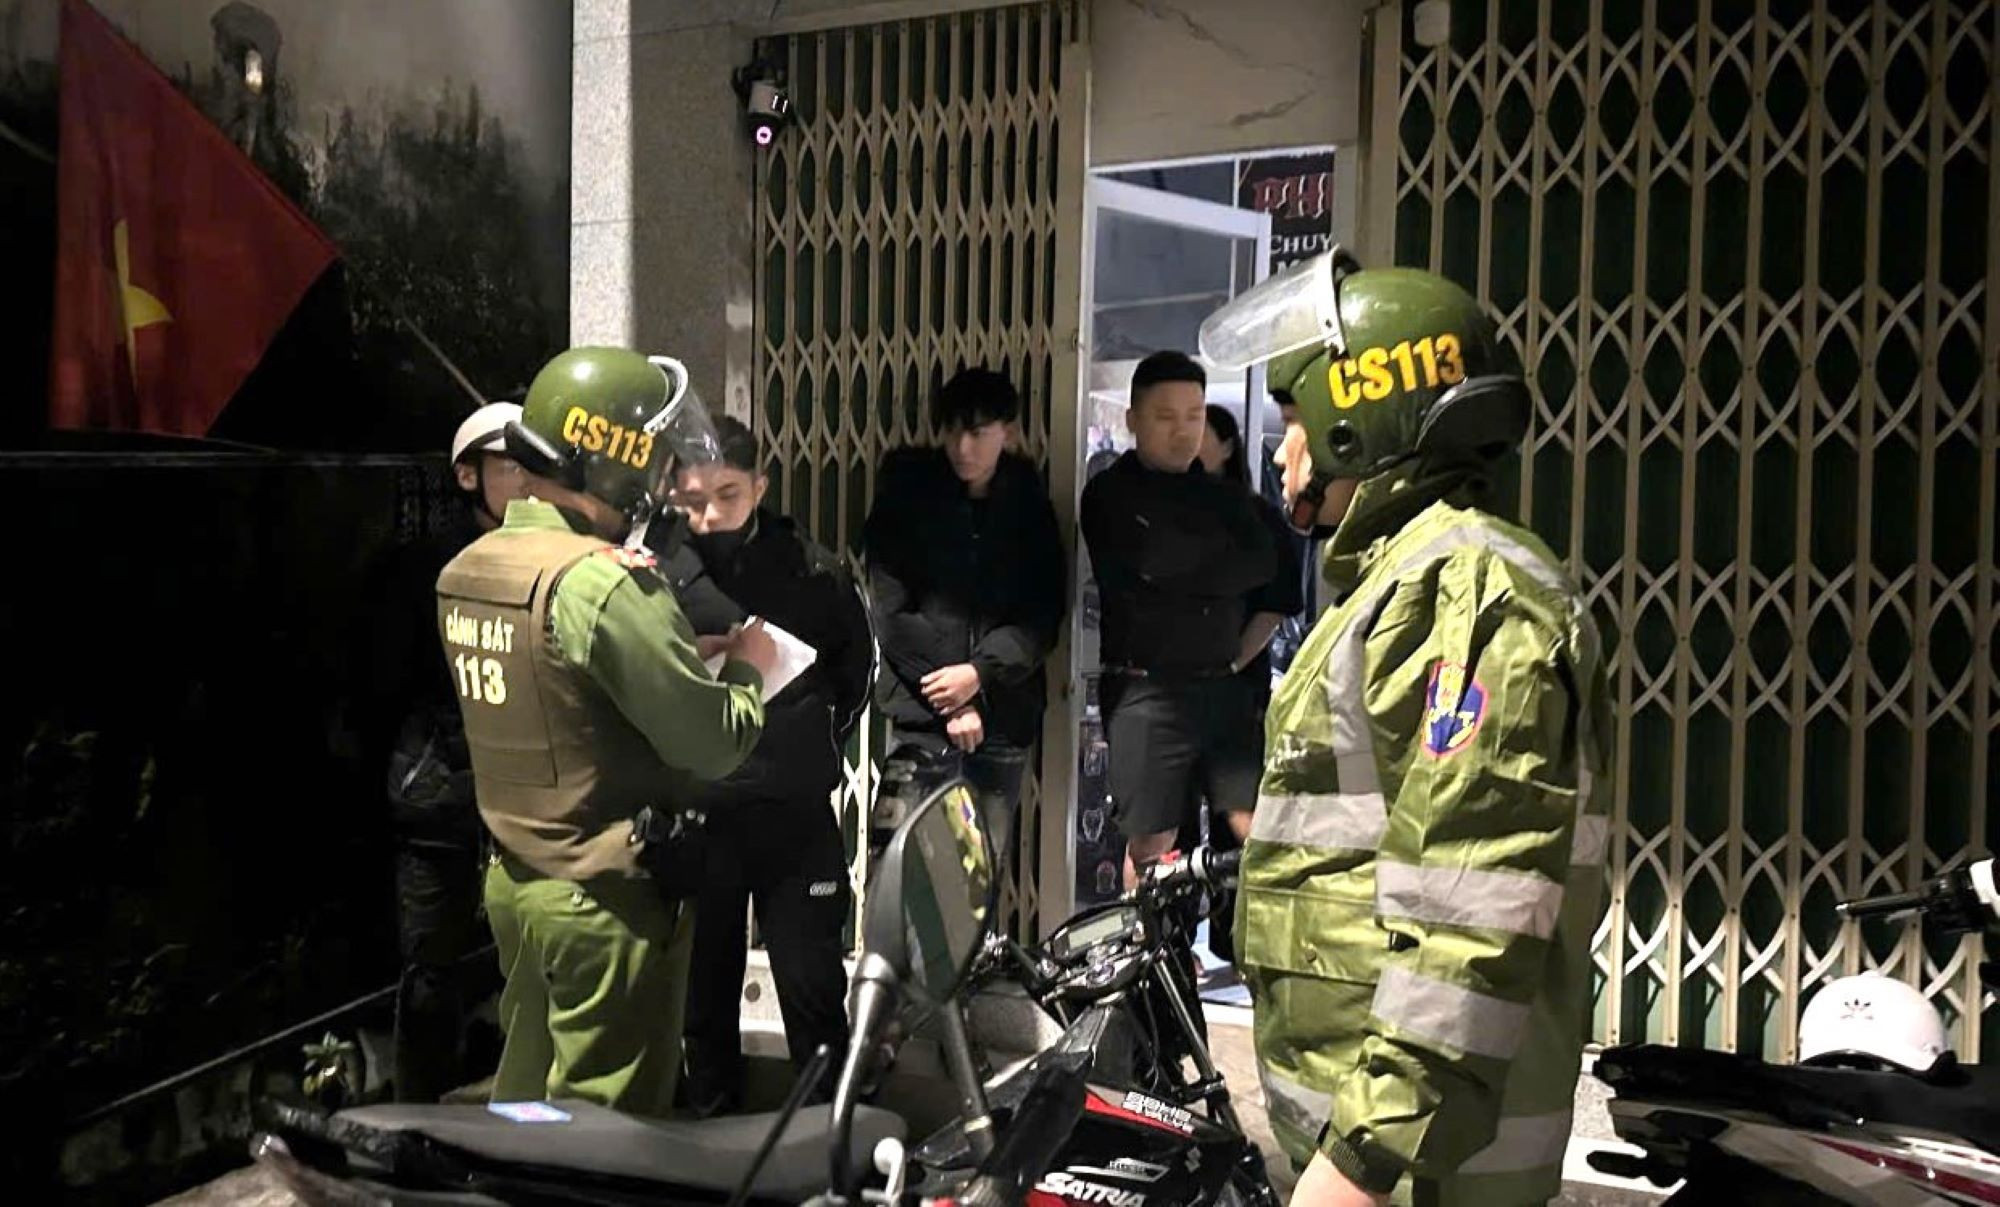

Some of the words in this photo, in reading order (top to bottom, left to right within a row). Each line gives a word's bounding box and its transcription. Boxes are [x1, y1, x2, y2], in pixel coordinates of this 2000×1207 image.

[1254, 173, 1333, 218] PH
[1328, 333, 1465, 409] CS113
[562, 405, 654, 469] CS113
[455, 653, 506, 704] 113
[1035, 1172, 1146, 1207] SATRIA
